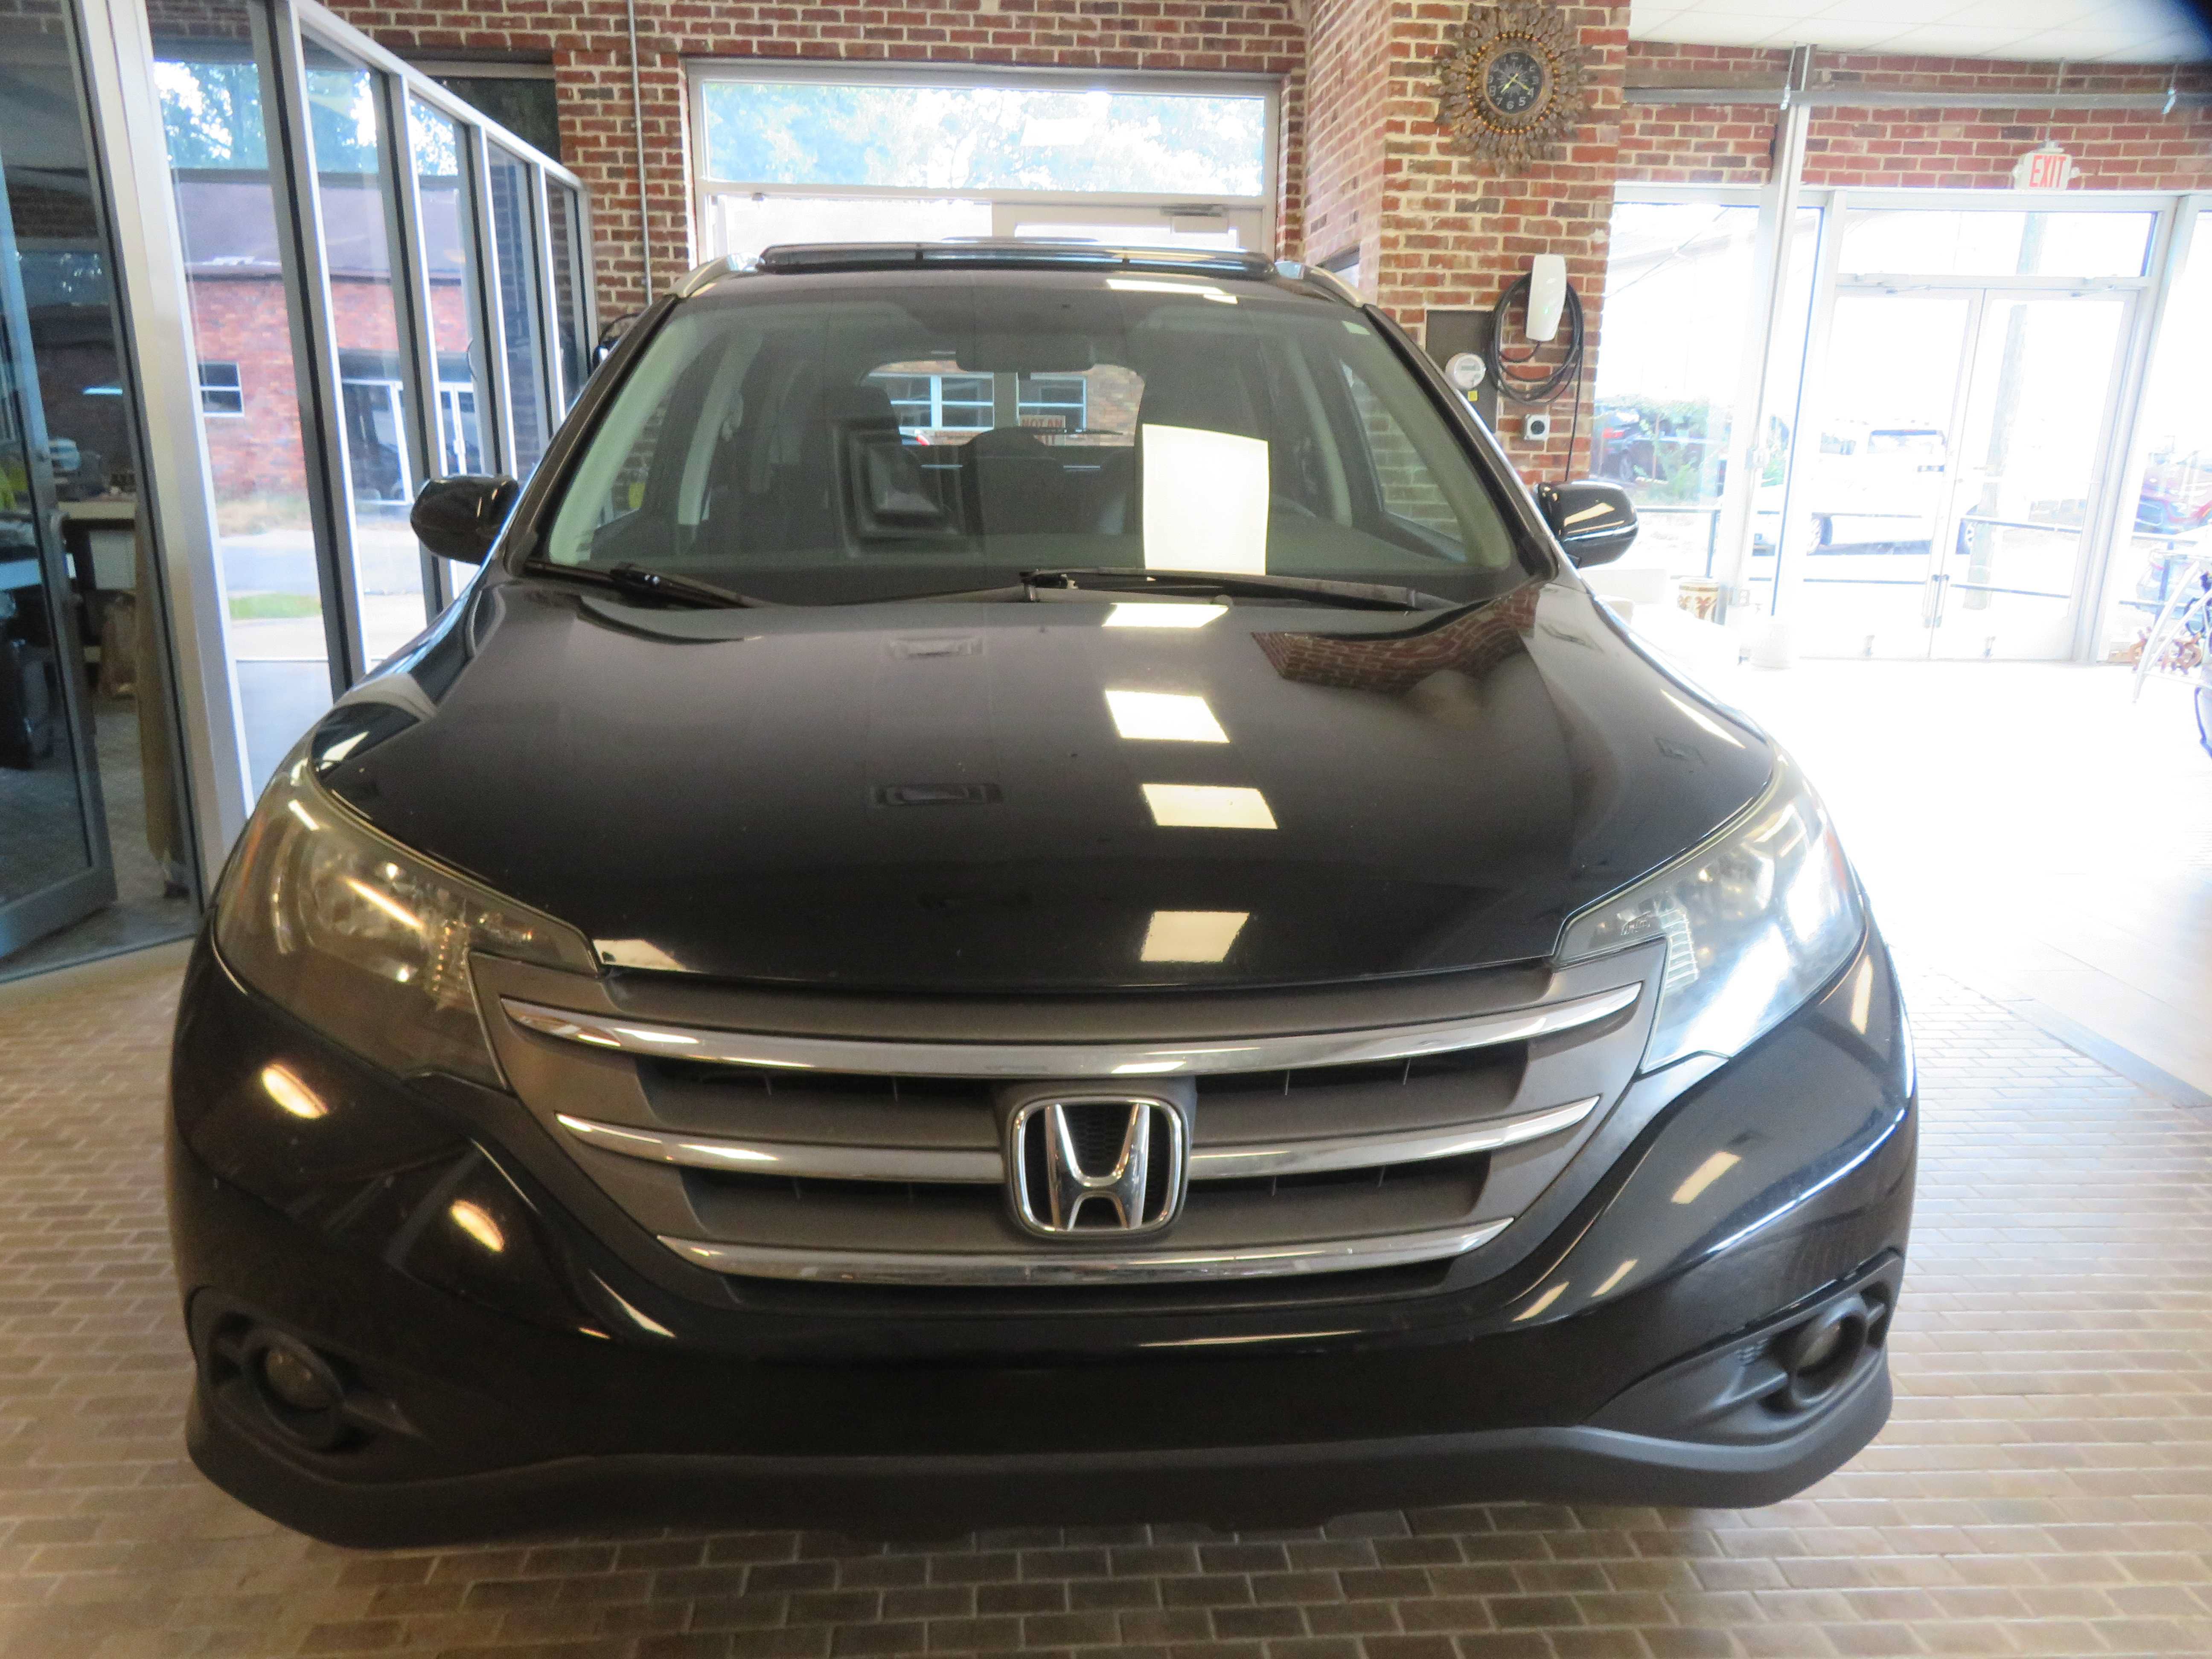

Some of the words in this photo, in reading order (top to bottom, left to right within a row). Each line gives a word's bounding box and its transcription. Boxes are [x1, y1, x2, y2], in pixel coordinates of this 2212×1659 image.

[1527, 87, 1534, 98] 4
[1496, 96, 1503, 106] 7
[1506, 101, 1515, 110] 6
[1519, 96, 1526, 107] 5
[2029, 154, 2066, 188] EXIT
